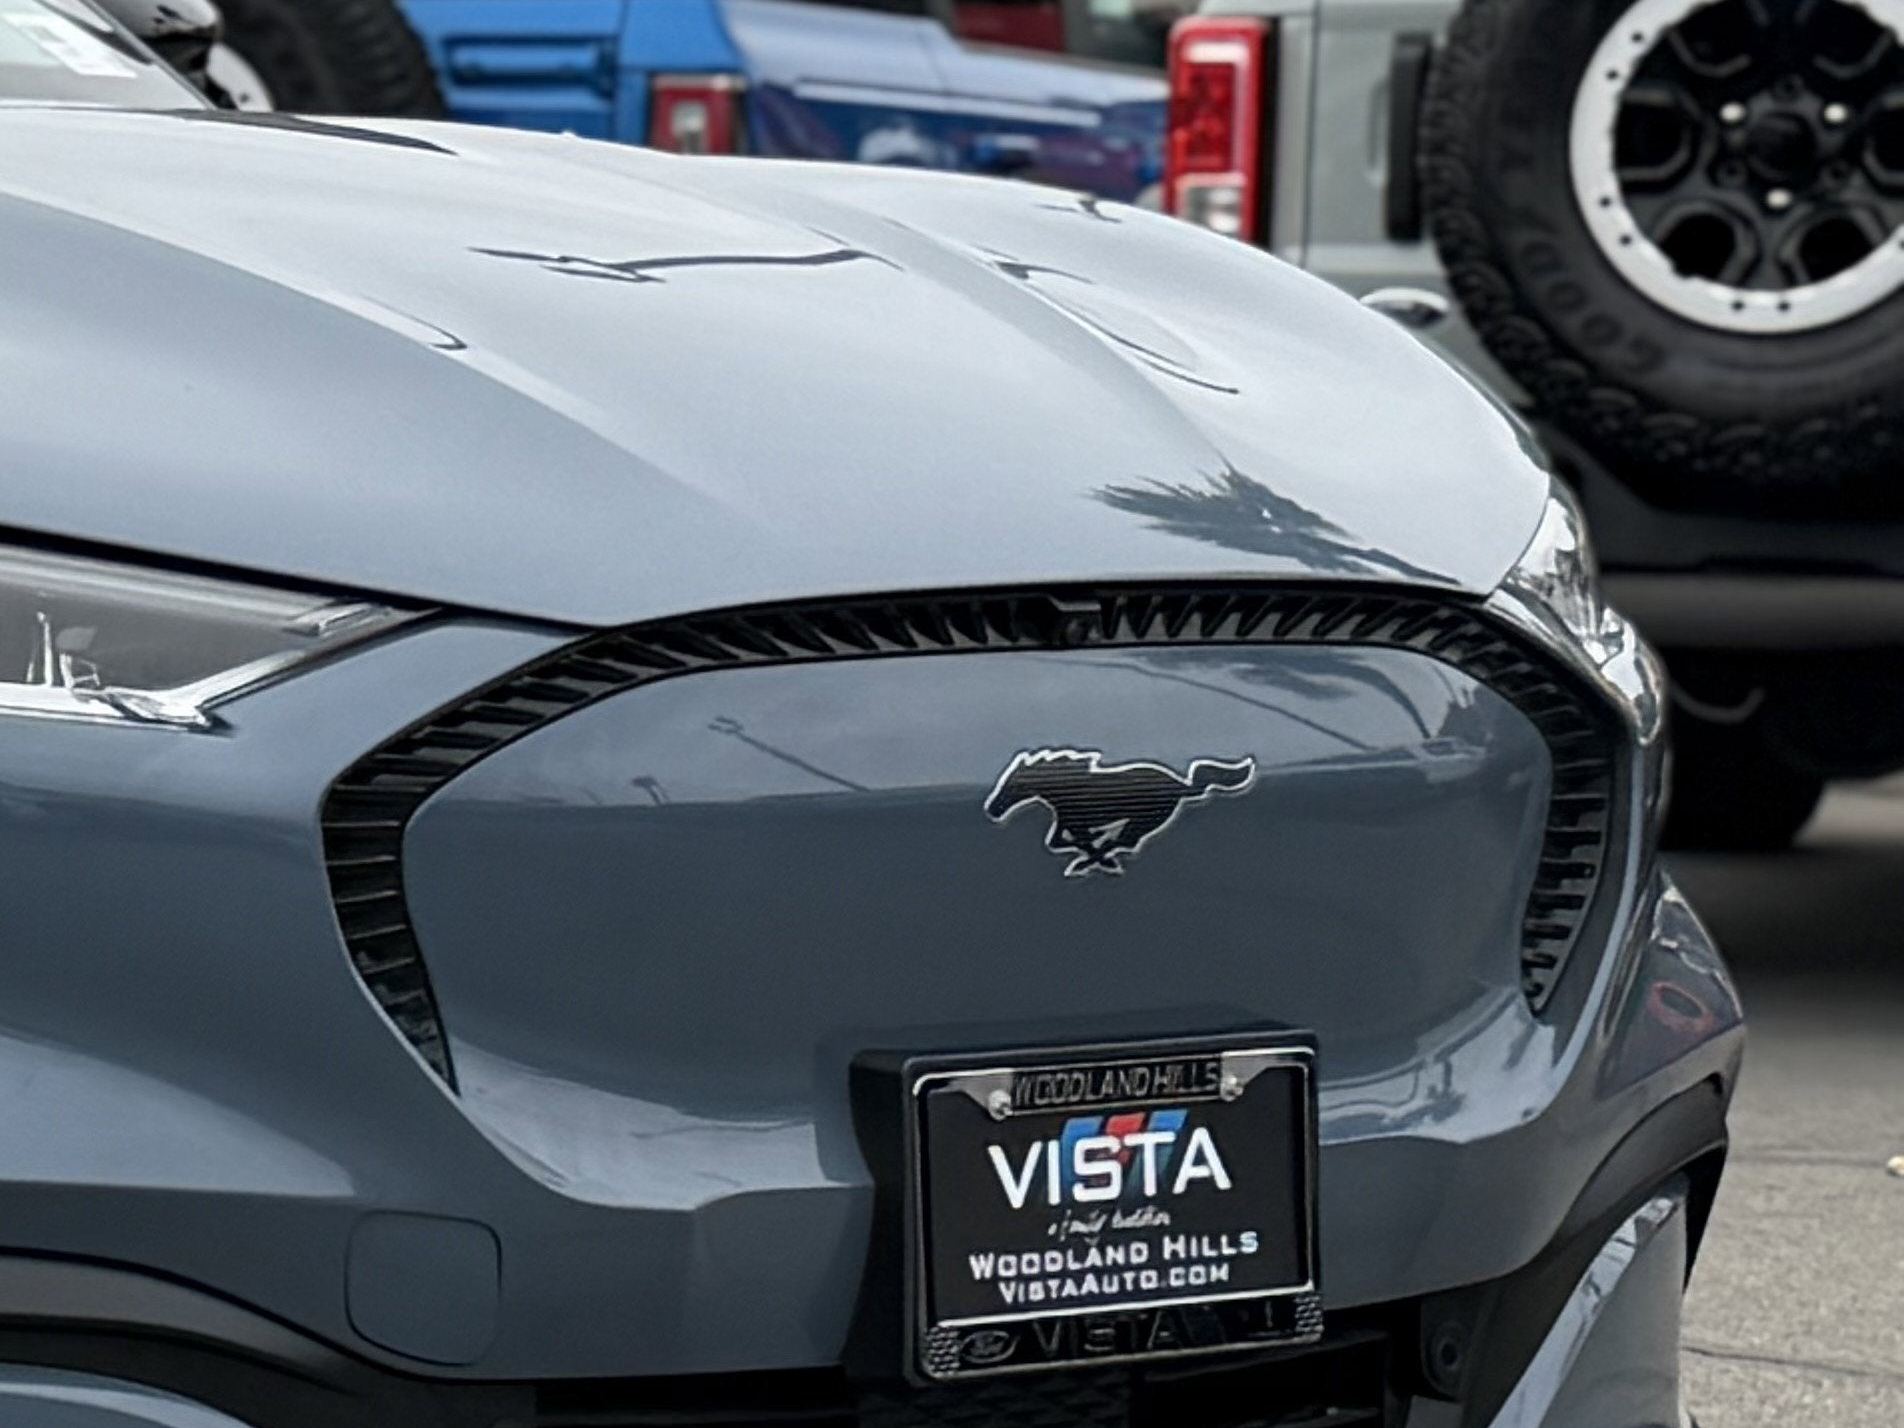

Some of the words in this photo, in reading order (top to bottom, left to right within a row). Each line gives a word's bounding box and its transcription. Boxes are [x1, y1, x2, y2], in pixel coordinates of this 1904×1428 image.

[1013, 1065, 1151, 1107] WOODLAND
[1152, 1061, 1219, 1097] HILLS
[987, 1126, 1233, 1210] VISTA
[968, 1238, 1151, 1282] WOODLAND
[1163, 1230, 1260, 1262] HILLS
